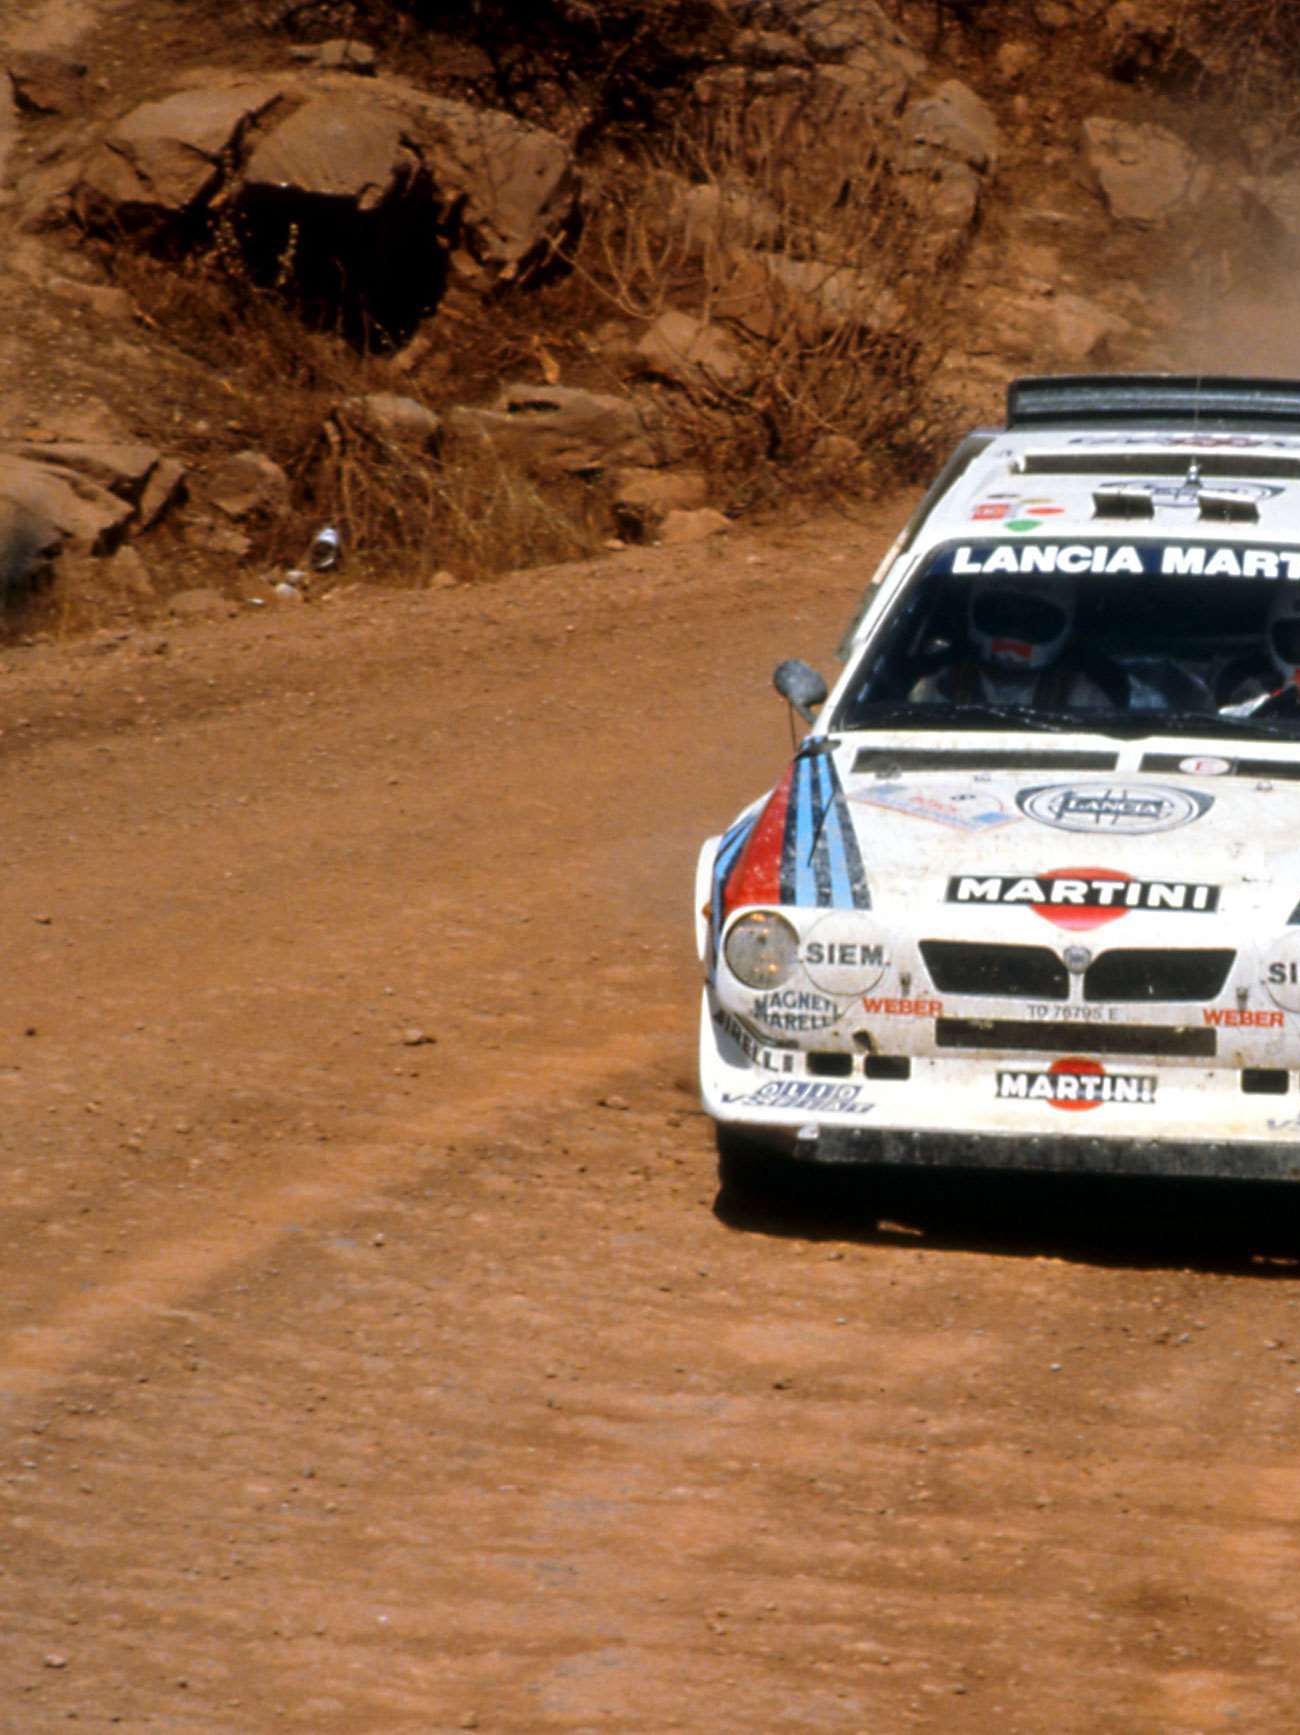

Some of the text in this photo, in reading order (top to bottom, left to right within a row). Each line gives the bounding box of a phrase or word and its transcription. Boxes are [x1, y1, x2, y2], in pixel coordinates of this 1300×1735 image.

[952, 545, 1144, 574] LANCIA
[957, 877, 1208, 909] MARTINI
[806, 941, 884, 965] SIEM
[863, 996, 944, 1017] WEBER
[1203, 1008, 1285, 1028] WEBER
[1001, 1073, 1153, 1100] MARTINI
